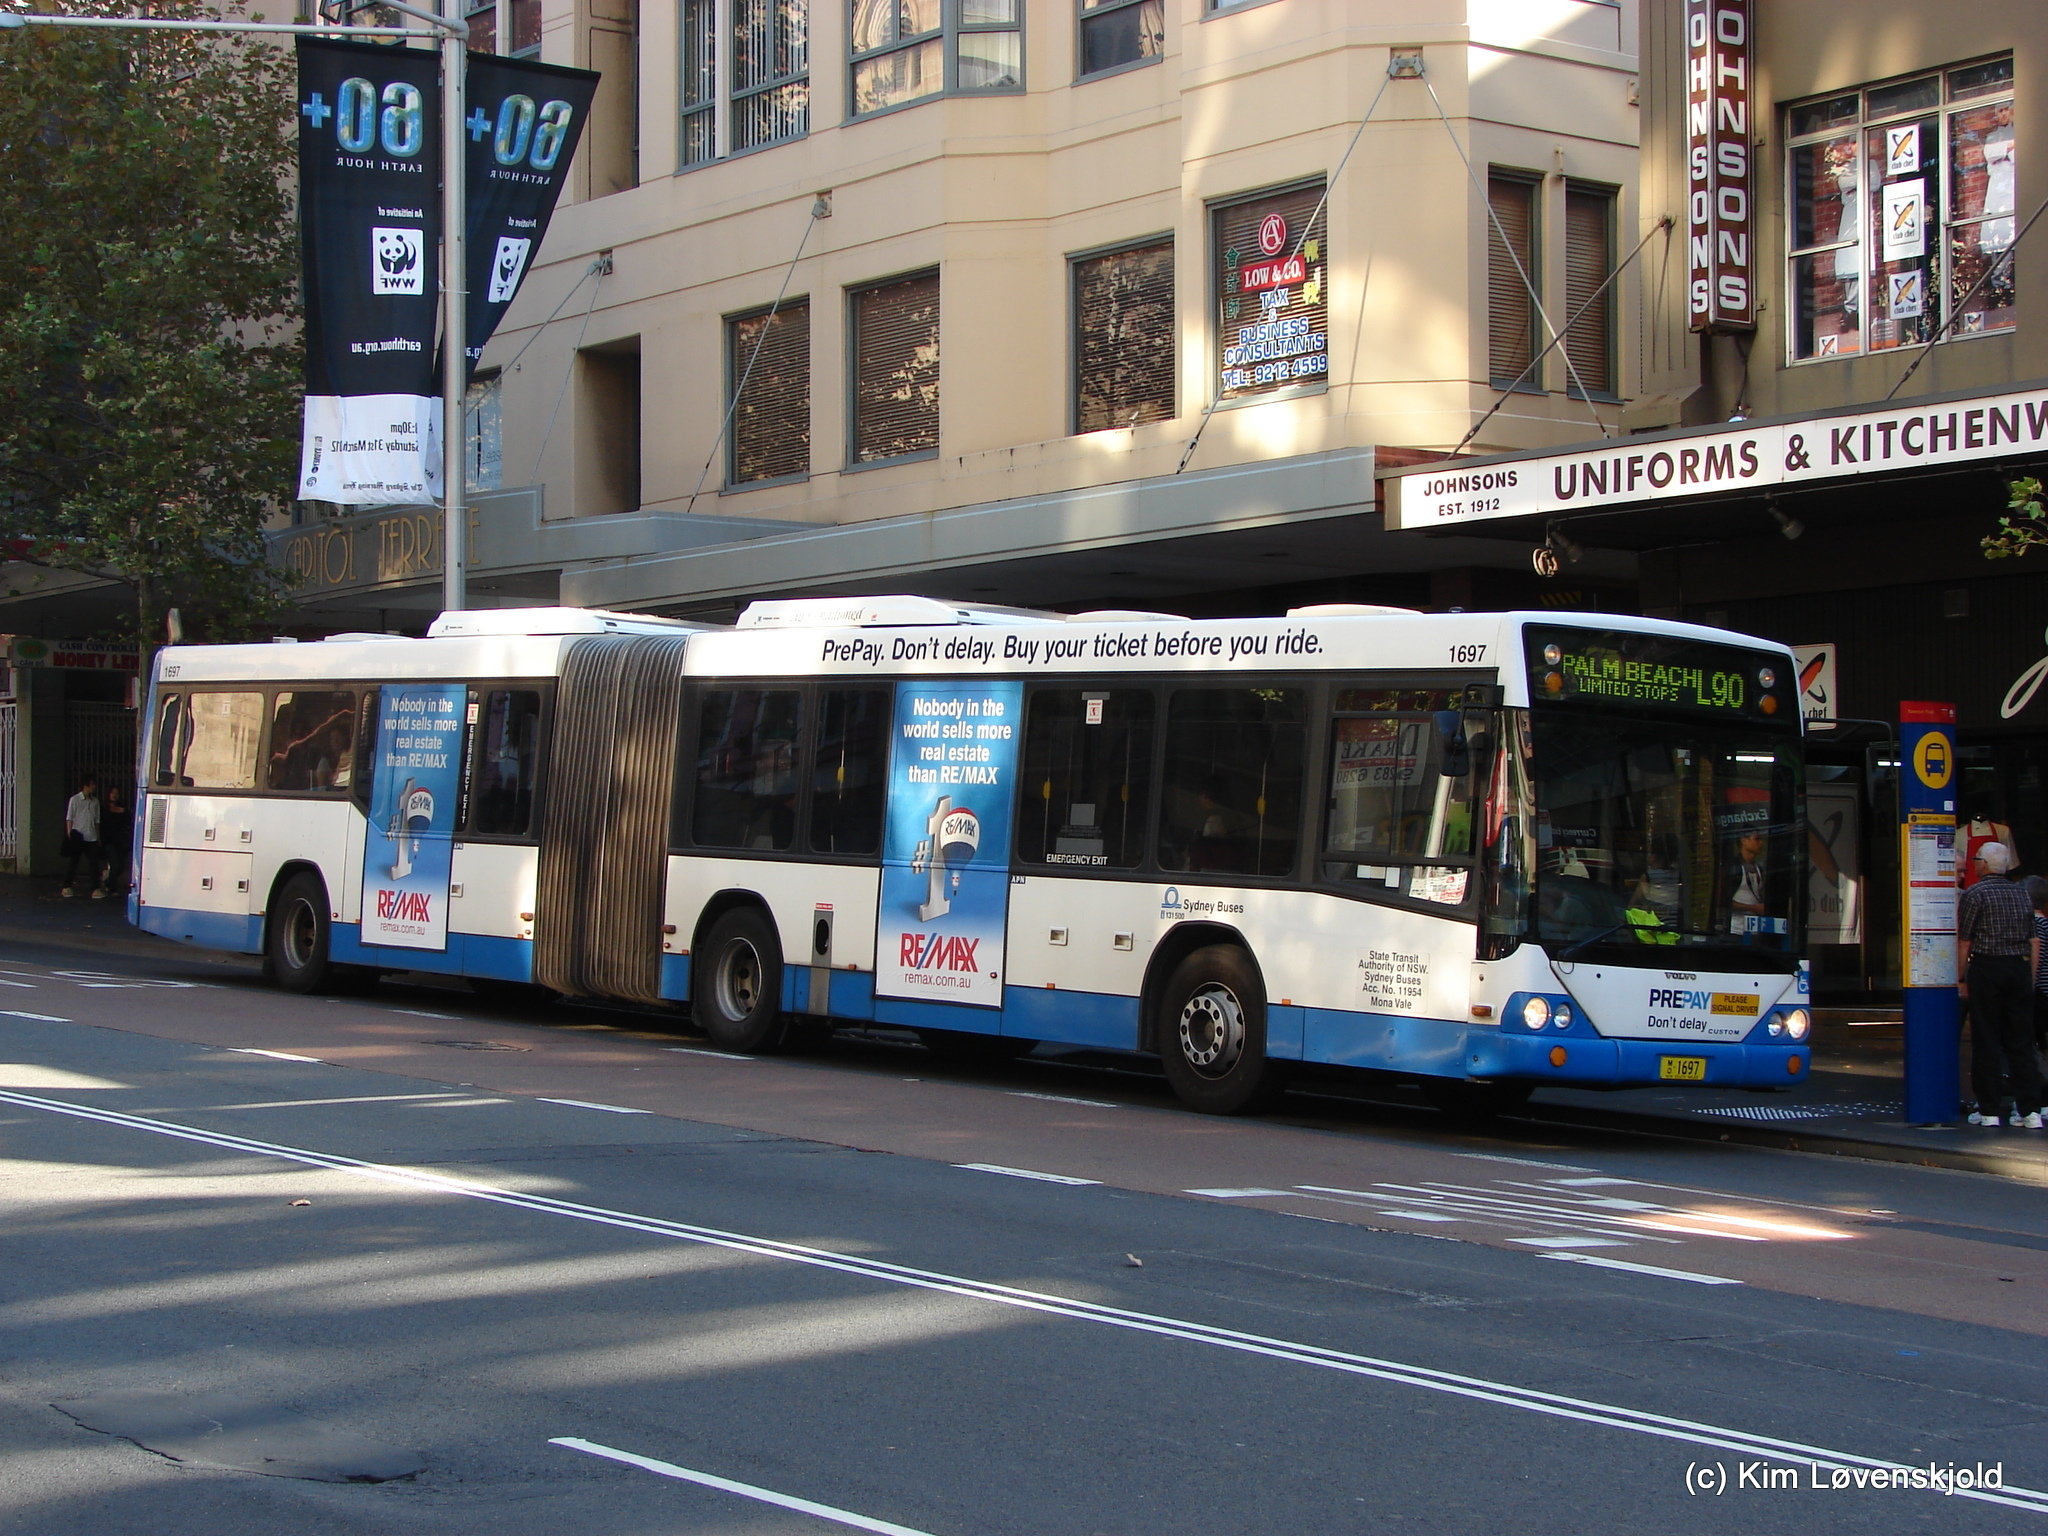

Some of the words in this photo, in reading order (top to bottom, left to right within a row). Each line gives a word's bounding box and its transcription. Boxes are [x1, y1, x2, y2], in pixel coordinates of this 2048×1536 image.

[1690, 0, 1708, 314] OHNSONS
[1717, 0, 1746, 311] OHNSONS
[1245, 266, 1269, 288] LOW
[1272, 265, 1281, 283] &
[1260, 289, 1289, 309] TAX
[1239, 317, 1309, 344] BUSINESS
[1225, 334, 1324, 365] CONSULTANTS
[1255, 362, 1290, 383] 9212
[1293, 355, 1328, 378] 4599
[1554, 440, 1759, 500] UNIFORMS
[1785, 434, 1811, 472] &
[1424, 470, 1518, 498] JOHNSONS
[1438, 502, 1464, 516] EST.
[1471, 498, 1500, 513] 1912
[59, 642, 83, 651] CASH
[822, 636, 886, 667] PrePay.
[892, 636, 941, 661] Don't
[945, 634, 997, 665] delay.
[1004, 635, 1039, 664] Buy
[1043, 636, 1087, 664] your
[1093, 631, 1148, 658] ticket
[1153, 629, 1222, 657] before
[1228, 634, 1269, 662] you
[1274, 627, 1324, 655] ride.
[1448, 644, 1487, 664] 1697
[53, 652, 107, 668] MONEY
[164, 666, 181, 678] 1697
[1562, 654, 1620, 679] PALM
[1625, 661, 1697, 688] BEACH
[1697, 669, 1744, 708] L90
[1579, 677, 1630, 698] LIMITED
[1634, 684, 1679, 702] STOPS
[391, 697, 427, 715] Nobody
[428, 698, 437, 713] in
[438, 698, 454, 713] the
[913, 698, 964, 717] Nobody
[967, 698, 979, 716] in
[982, 698, 1004, 717] the
[384, 715, 409, 731] world
[411, 716, 432, 731] sells
[434, 718, 457, 732] more
[903, 721, 939, 738] world
[942, 722, 973, 739] sells
[977, 725, 1012, 740] more
[395, 735, 413, 749] real
[414, 736, 442, 749] estate
[386, 753, 407, 767] than
[408, 753, 448, 769] RE/MAX
[463, 725, 476, 792] EMERGENCY
[920, 744, 945, 761] real
[948, 745, 990, 762] estate
[908, 766, 937, 783] than
[940, 766, 999, 785] RE/MAX
[461, 794, 469, 824] EXIT
[945, 815, 977, 837] RE/MAX
[1046, 853, 1091, 865] EMERGENCY
[1092, 856, 1108, 867] EXIT
[1011, 875, 1026, 884] APN
[377, 889, 432, 923] RE/MAX
[1183, 899, 1215, 914] Sydney
[1217, 901, 1244, 914] Buses
[1165, 911, 1185, 920] 131500
[380, 921, 426, 936] remax.com.au
[899, 932, 980, 973] RE/MAX
[1369, 950, 1389, 961] State
[1392, 952, 1419, 963] Transit
[1358, 960, 1395, 974] Authority
[1396, 962, 1405, 972] of
[1406, 963, 1429, 974] NSW.
[1664, 972, 1697, 980] VOLVO
[904, 972, 971, 989] remax.com.au
[1364, 972, 1394, 985] Sydney
[1396, 974, 1421, 985] Buses
[1362, 984, 1378, 994] Acc.
[1380, 984, 1396, 995] No.
[1398, 986, 1422, 997] 11954
[1649, 988, 1712, 1009] PREPAY
[1724, 995, 1748, 1004] PLEASE
[1370, 997, 1392, 1008] Mona
[1394, 998, 1412, 1010] Vale
[1711, 1004, 1734, 1013] SIGNAL
[1736, 1005, 1758, 1014] DRIVER
[1648, 1016, 1676, 1029] Don't
[1679, 1017, 1707, 1033] delay
[1677, 1060, 1700, 1075] 1697
